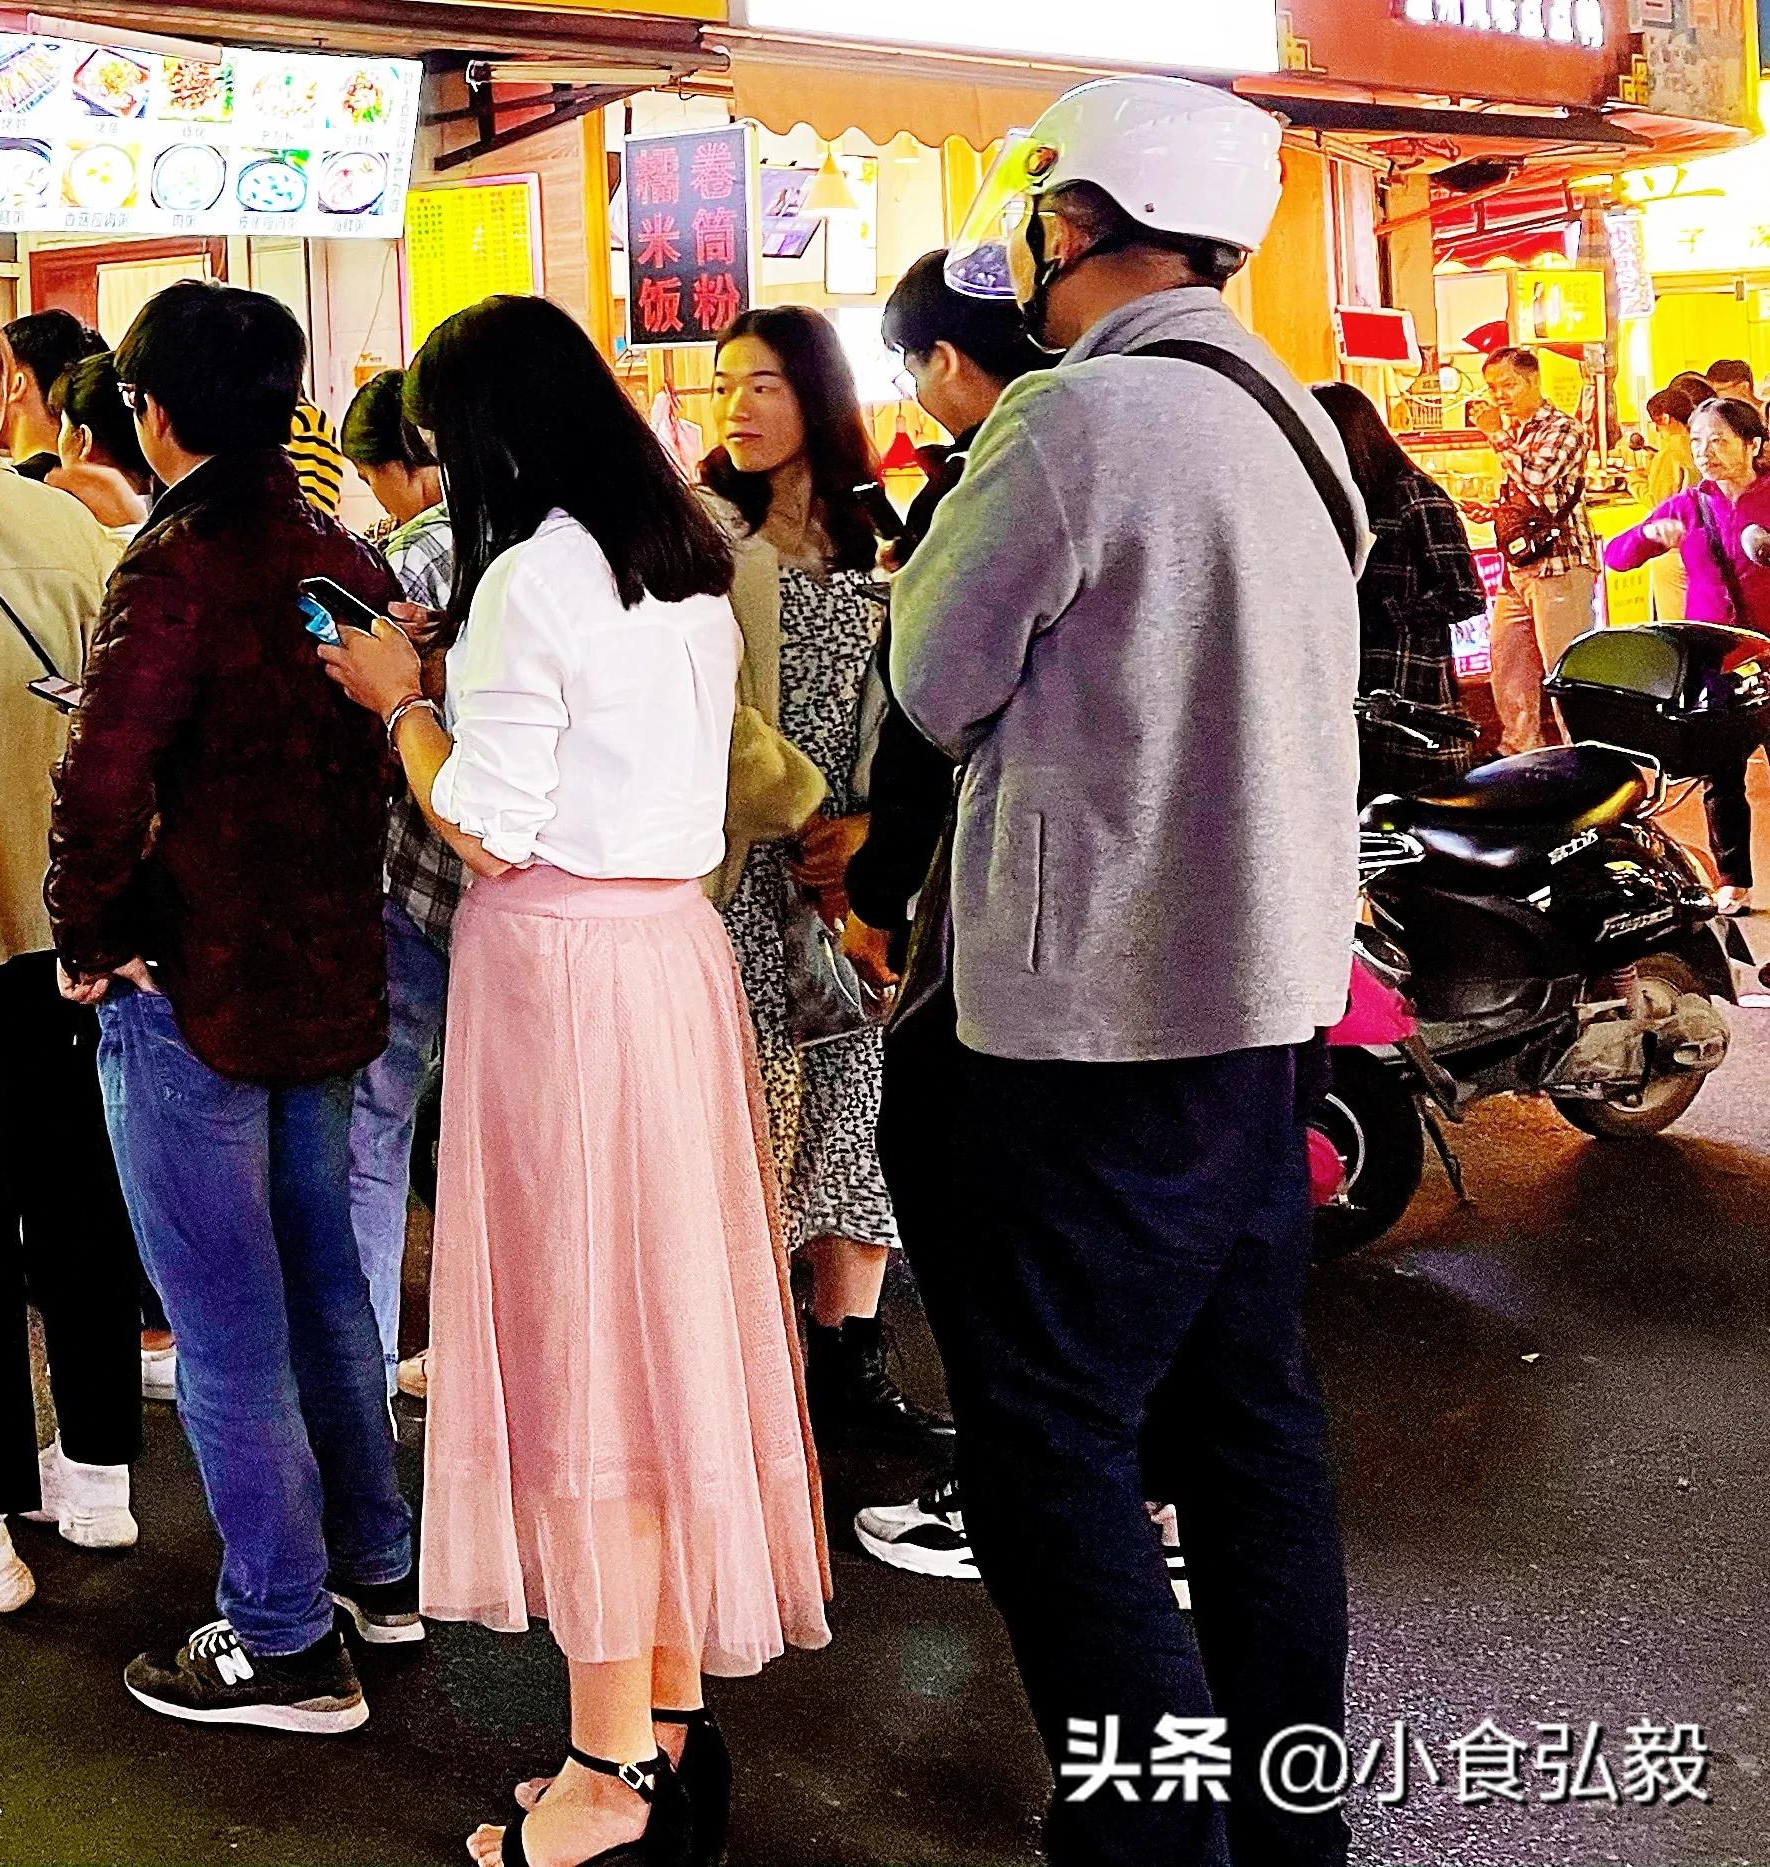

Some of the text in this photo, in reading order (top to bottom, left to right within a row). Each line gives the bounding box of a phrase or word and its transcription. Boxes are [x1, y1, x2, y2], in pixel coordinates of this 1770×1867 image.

[634, 146, 684, 333] 糯米饭
[690, 142, 741, 331] 卷筒粉
